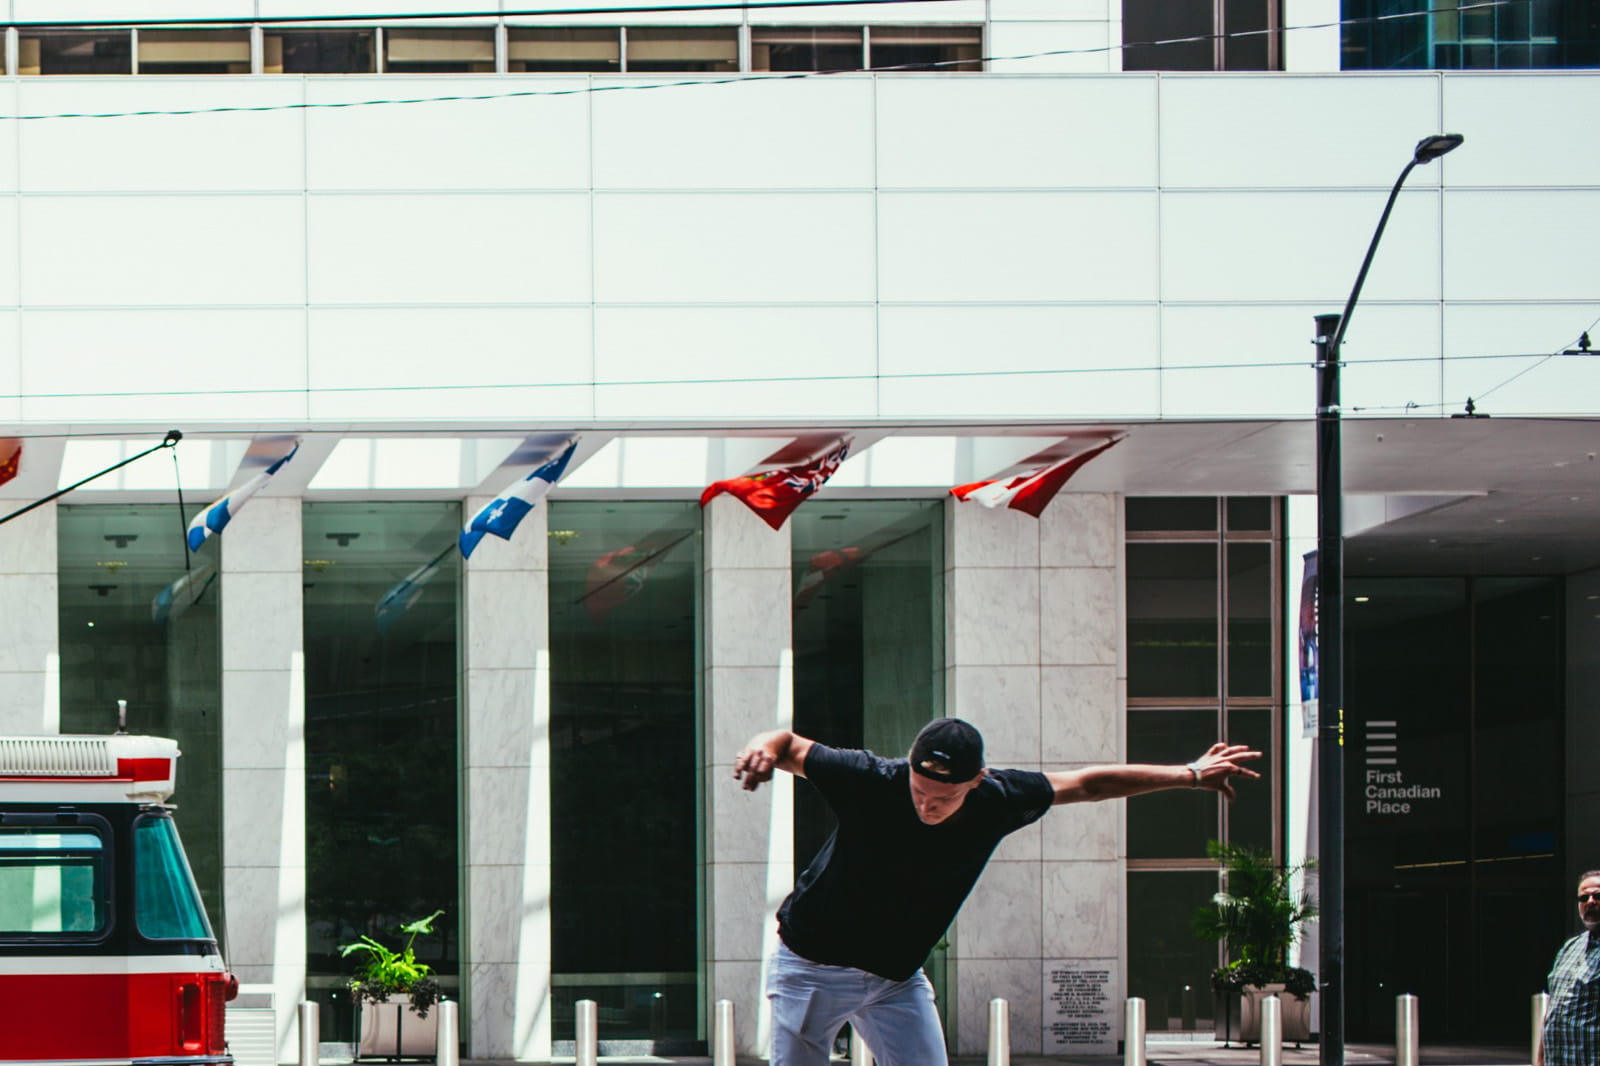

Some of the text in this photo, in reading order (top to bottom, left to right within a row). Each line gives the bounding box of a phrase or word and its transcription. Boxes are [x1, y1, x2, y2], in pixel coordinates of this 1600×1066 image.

[1366, 770, 1403, 783] First
[1365, 785, 1441, 799] Canadian
[1366, 800, 1411, 814] Place
